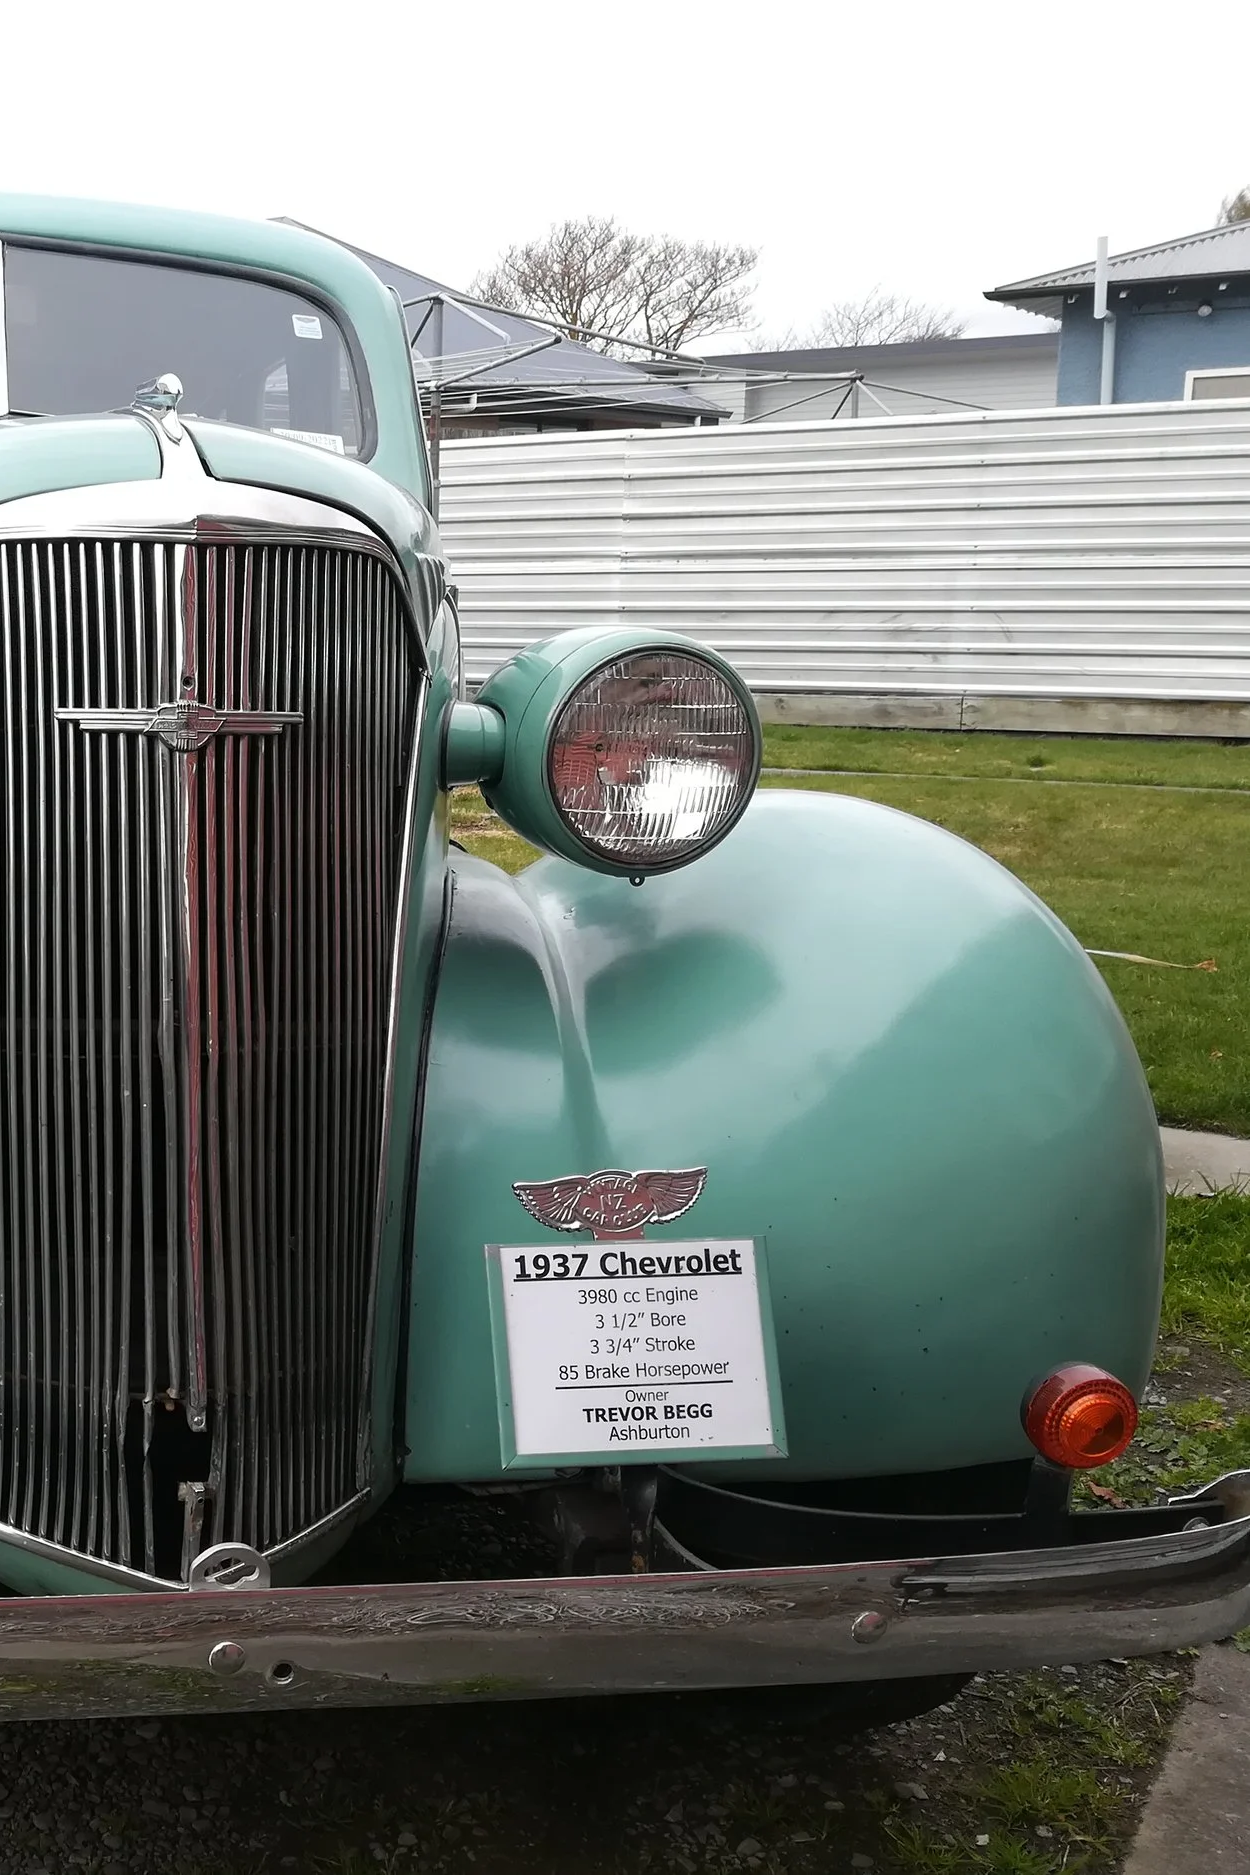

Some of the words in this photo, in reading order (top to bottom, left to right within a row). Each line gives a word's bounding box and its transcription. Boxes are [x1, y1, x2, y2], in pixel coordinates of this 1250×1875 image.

[514, 1253, 589, 1279] 1937
[600, 1248, 742, 1276] Chevrolet
[578, 1289, 617, 1304] 3980
[623, 1293, 641, 1303] cc
[646, 1286, 699, 1305] Engine
[595, 1314, 605, 1329] 3
[651, 1312, 686, 1327] Bore
[590, 1339, 600, 1355] 3
[645, 1336, 696, 1352] Stroke
[559, 1365, 579, 1380] 85
[585, 1363, 630, 1379] Brake
[636, 1361, 730, 1379] Horsepower
[625, 1389, 669, 1403] Owner
[583, 1406, 658, 1423] TREVOR
[664, 1403, 713, 1420] BEGG
[609, 1424, 690, 1441] Ashburton
